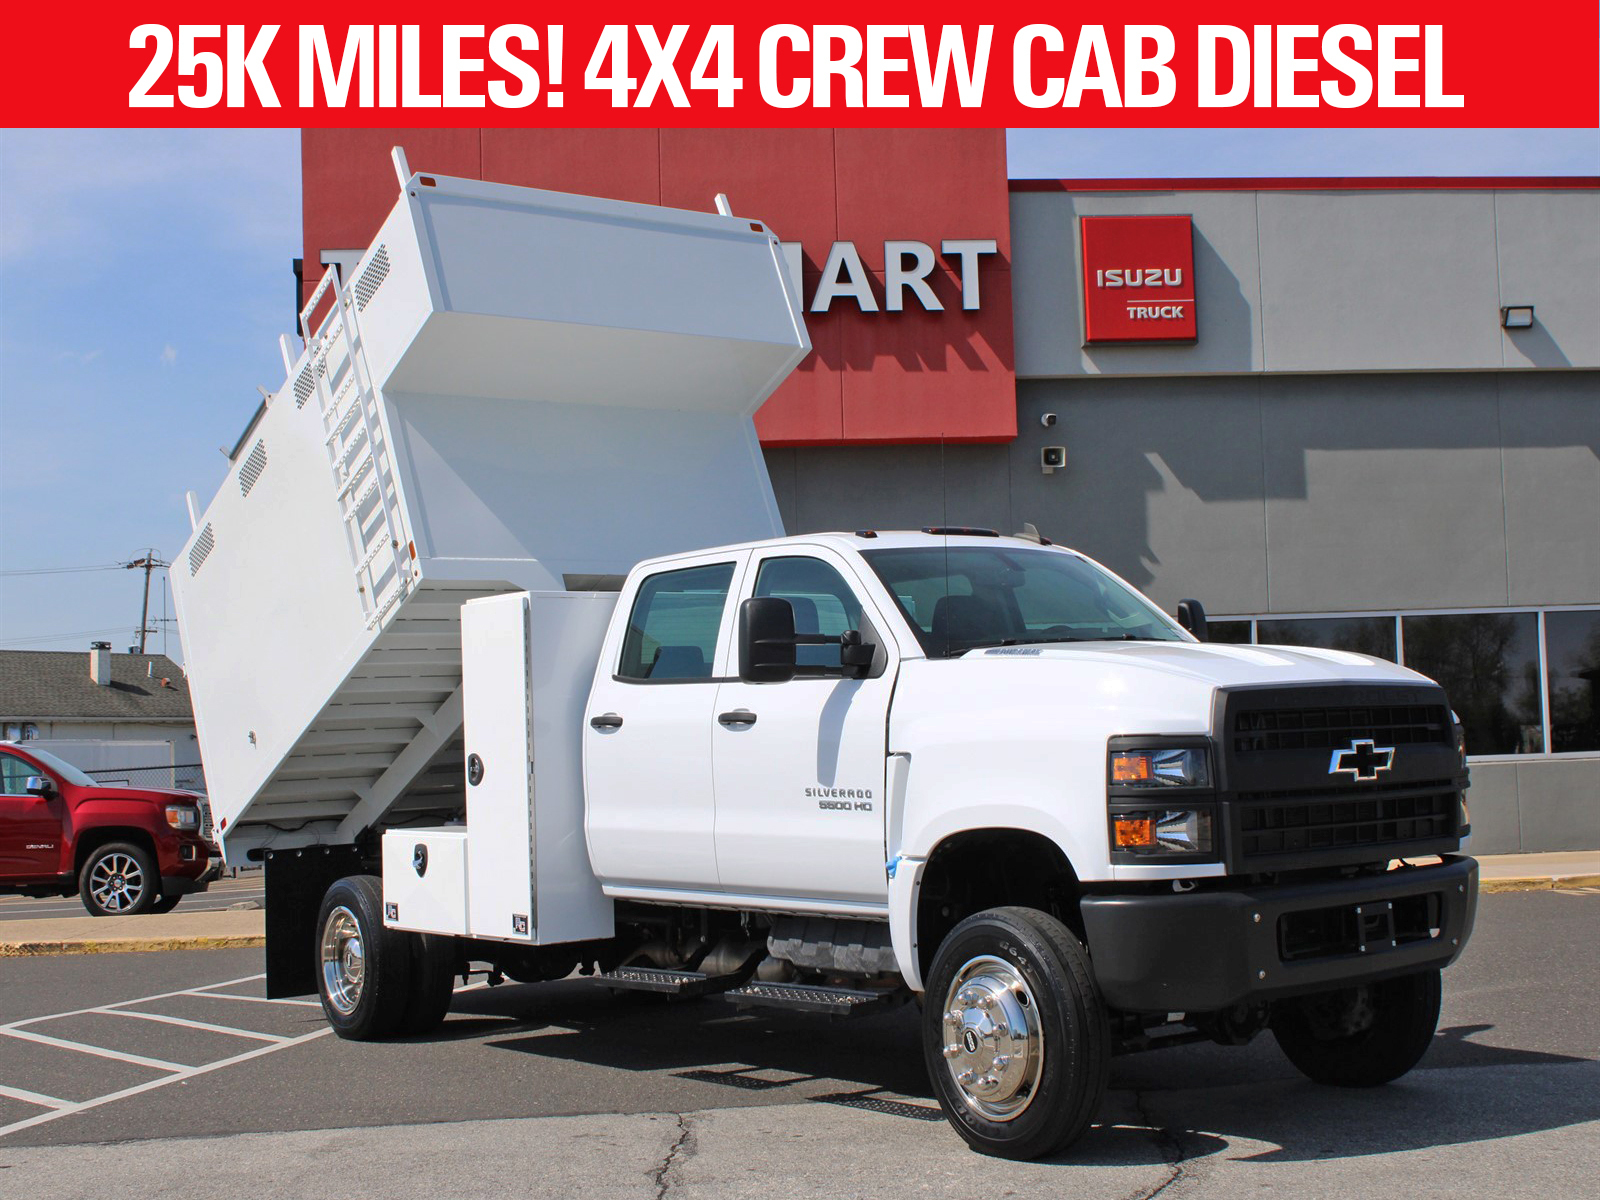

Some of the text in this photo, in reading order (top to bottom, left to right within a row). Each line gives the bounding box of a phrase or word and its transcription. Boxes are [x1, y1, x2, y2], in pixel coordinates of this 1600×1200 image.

[1097, 268, 1182, 287] ISUZU
[1126, 306, 1184, 319] TRUCK
[805, 787, 873, 799] SILVERADO
[818, 800, 873, 811] 5500 HD
